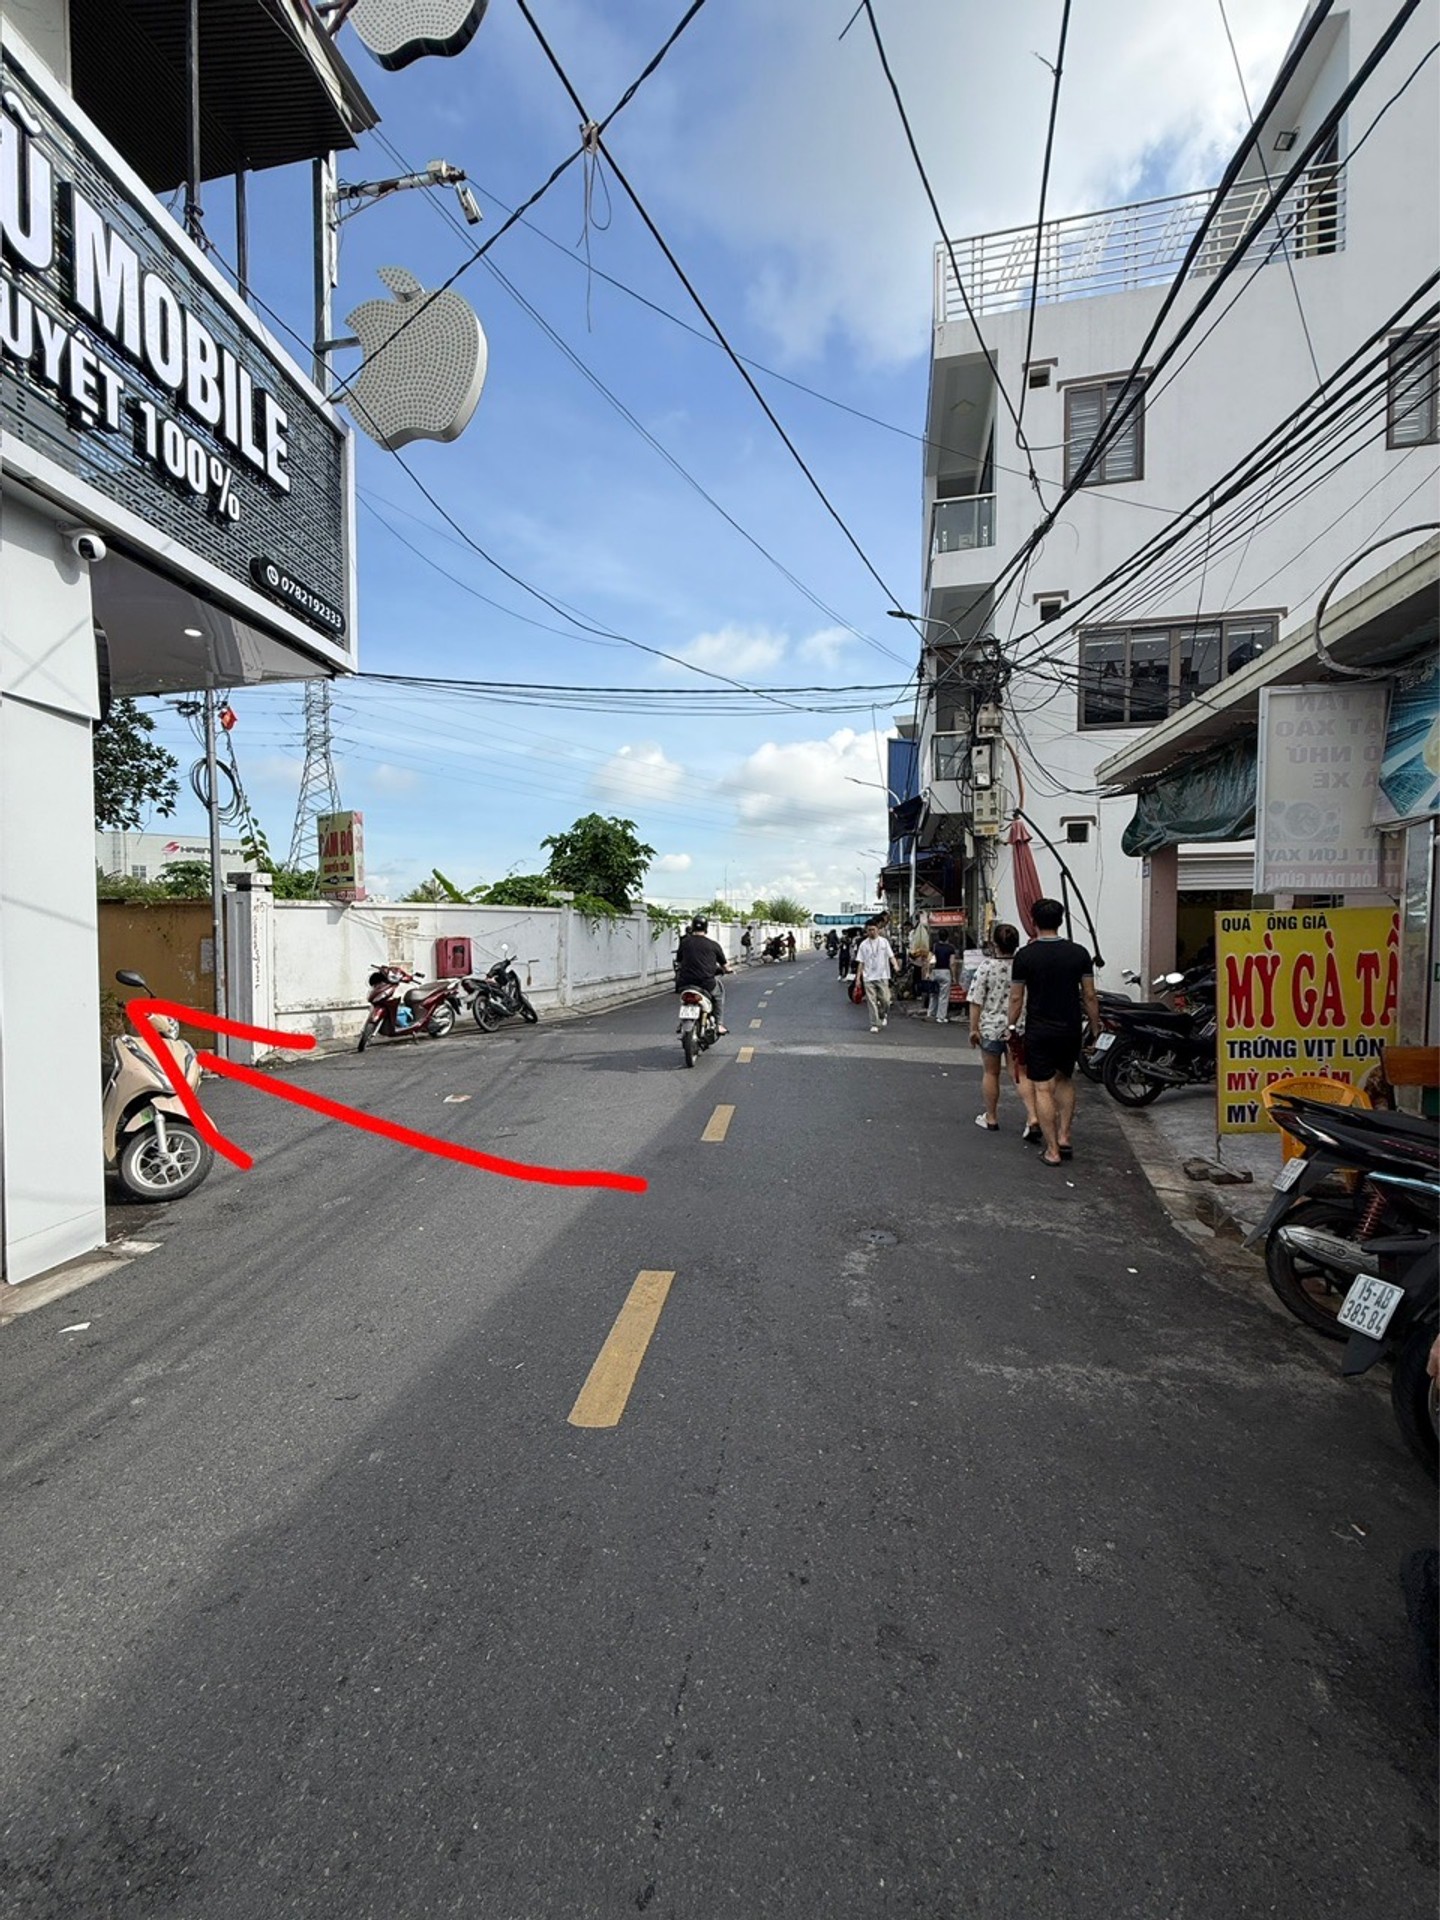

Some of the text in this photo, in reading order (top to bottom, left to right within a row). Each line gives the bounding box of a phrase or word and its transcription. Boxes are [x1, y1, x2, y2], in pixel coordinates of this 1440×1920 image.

[74, 189, 290, 493] MOBILE
[140, 400, 240, 521] 100%
[281, 576, 342, 628] 0782192333
[1267, 913, 1298, 931] ÔNG
[1225, 932, 1281, 1029] MỲ
[1292, 931, 1346, 1028] GÀ
[1226, 1034, 1385, 1062] TRỨNG VỊT LỘN
[1227, 1068, 1260, 1091] MỲ
[1227, 1101, 1260, 1124] MỲ
[1342, 1299, 1387, 1335] 385.84
